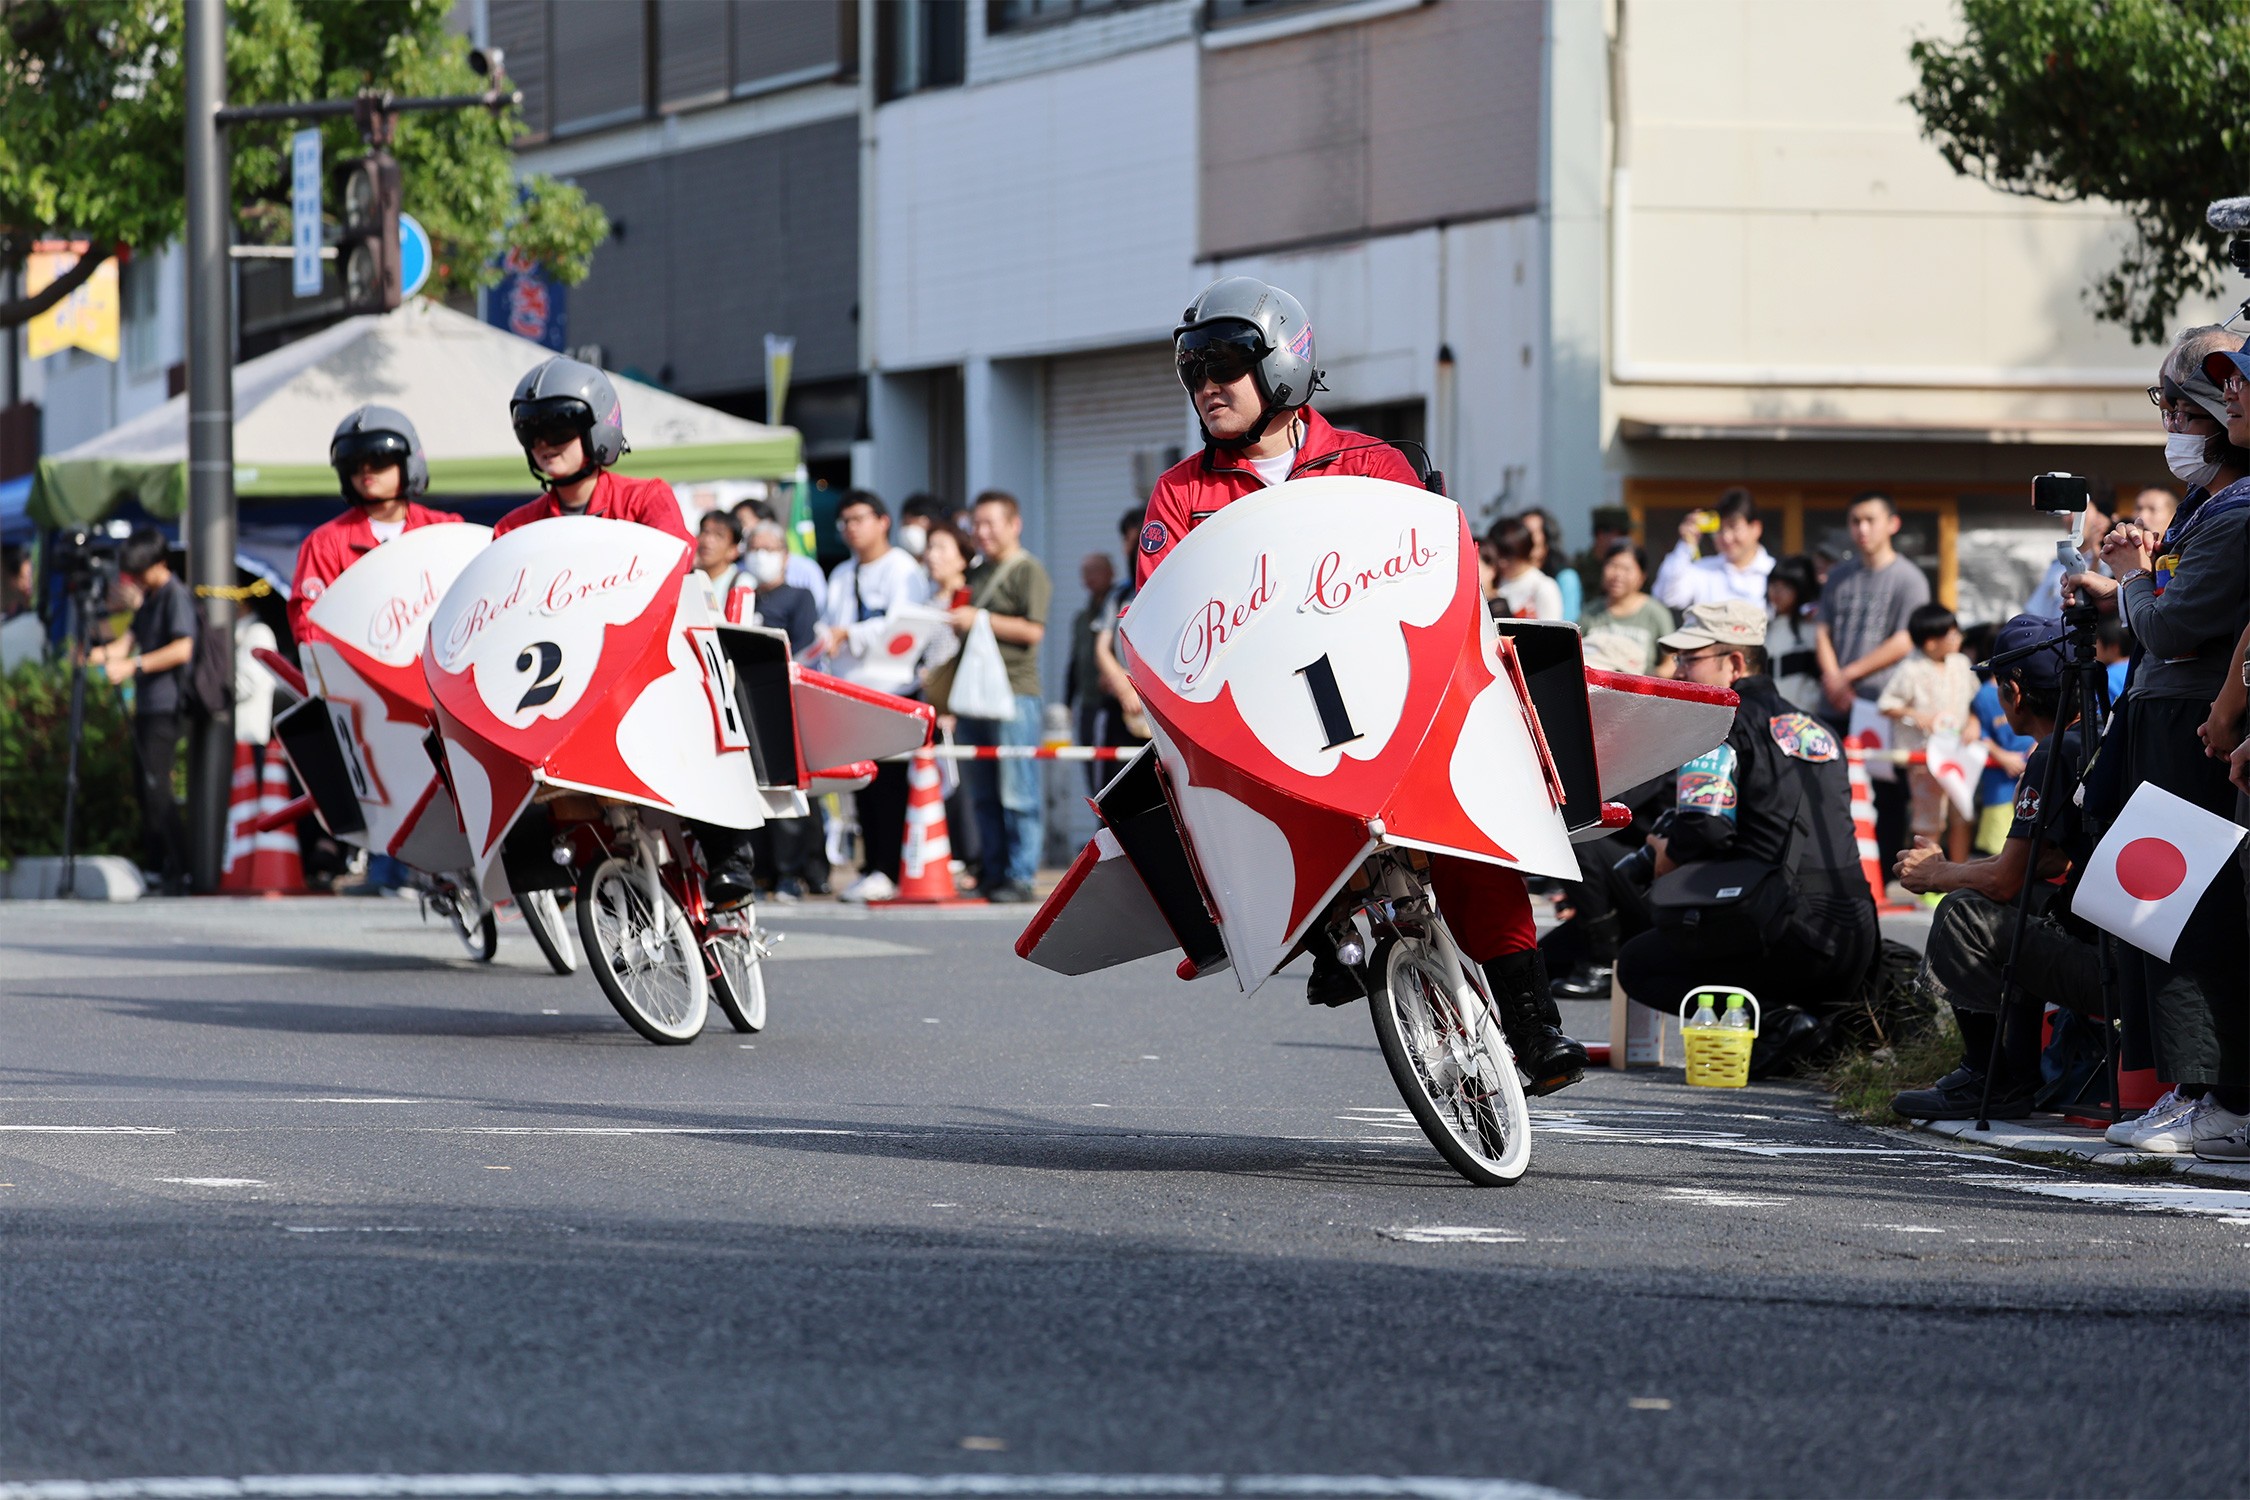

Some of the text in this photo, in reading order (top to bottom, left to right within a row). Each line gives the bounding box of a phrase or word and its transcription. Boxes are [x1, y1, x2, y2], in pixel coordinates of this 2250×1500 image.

[375, 569, 437, 650] Red
[450, 555, 648, 660] Red Crab
[1180, 527, 1438, 684] Red Crab
[515, 641, 564, 714] 2
[1293, 652, 1365, 751] 1
